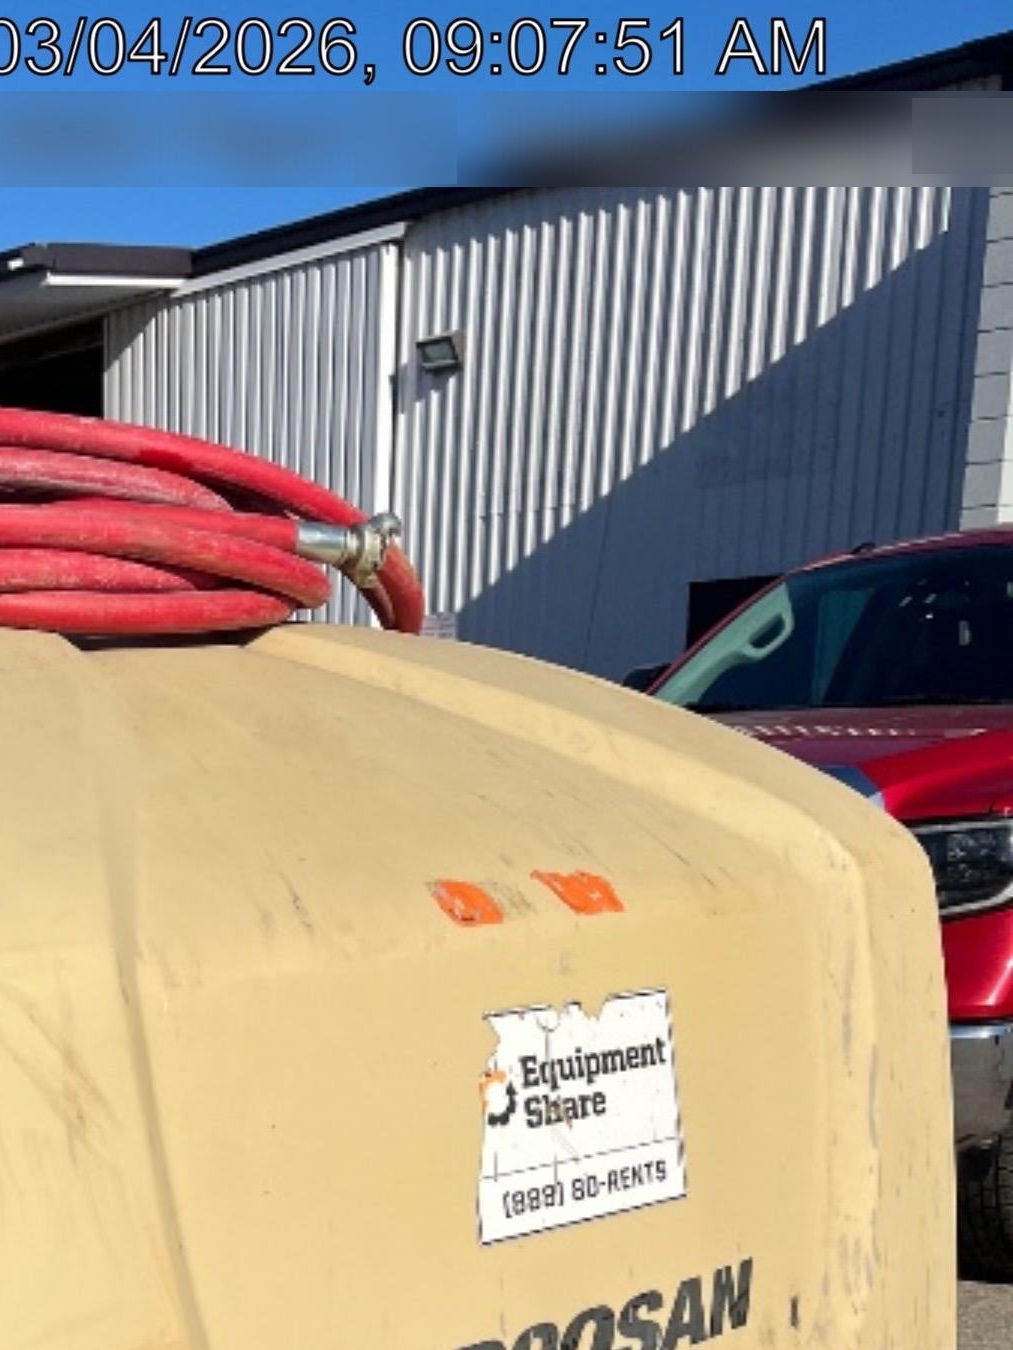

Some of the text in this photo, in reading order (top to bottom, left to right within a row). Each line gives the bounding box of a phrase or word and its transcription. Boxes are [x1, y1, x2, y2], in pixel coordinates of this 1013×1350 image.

[519, 1036, 667, 1092] Equipment
[523, 1090, 607, 1129] Share
[571, 1159, 667, 1202] 80-RENTS
